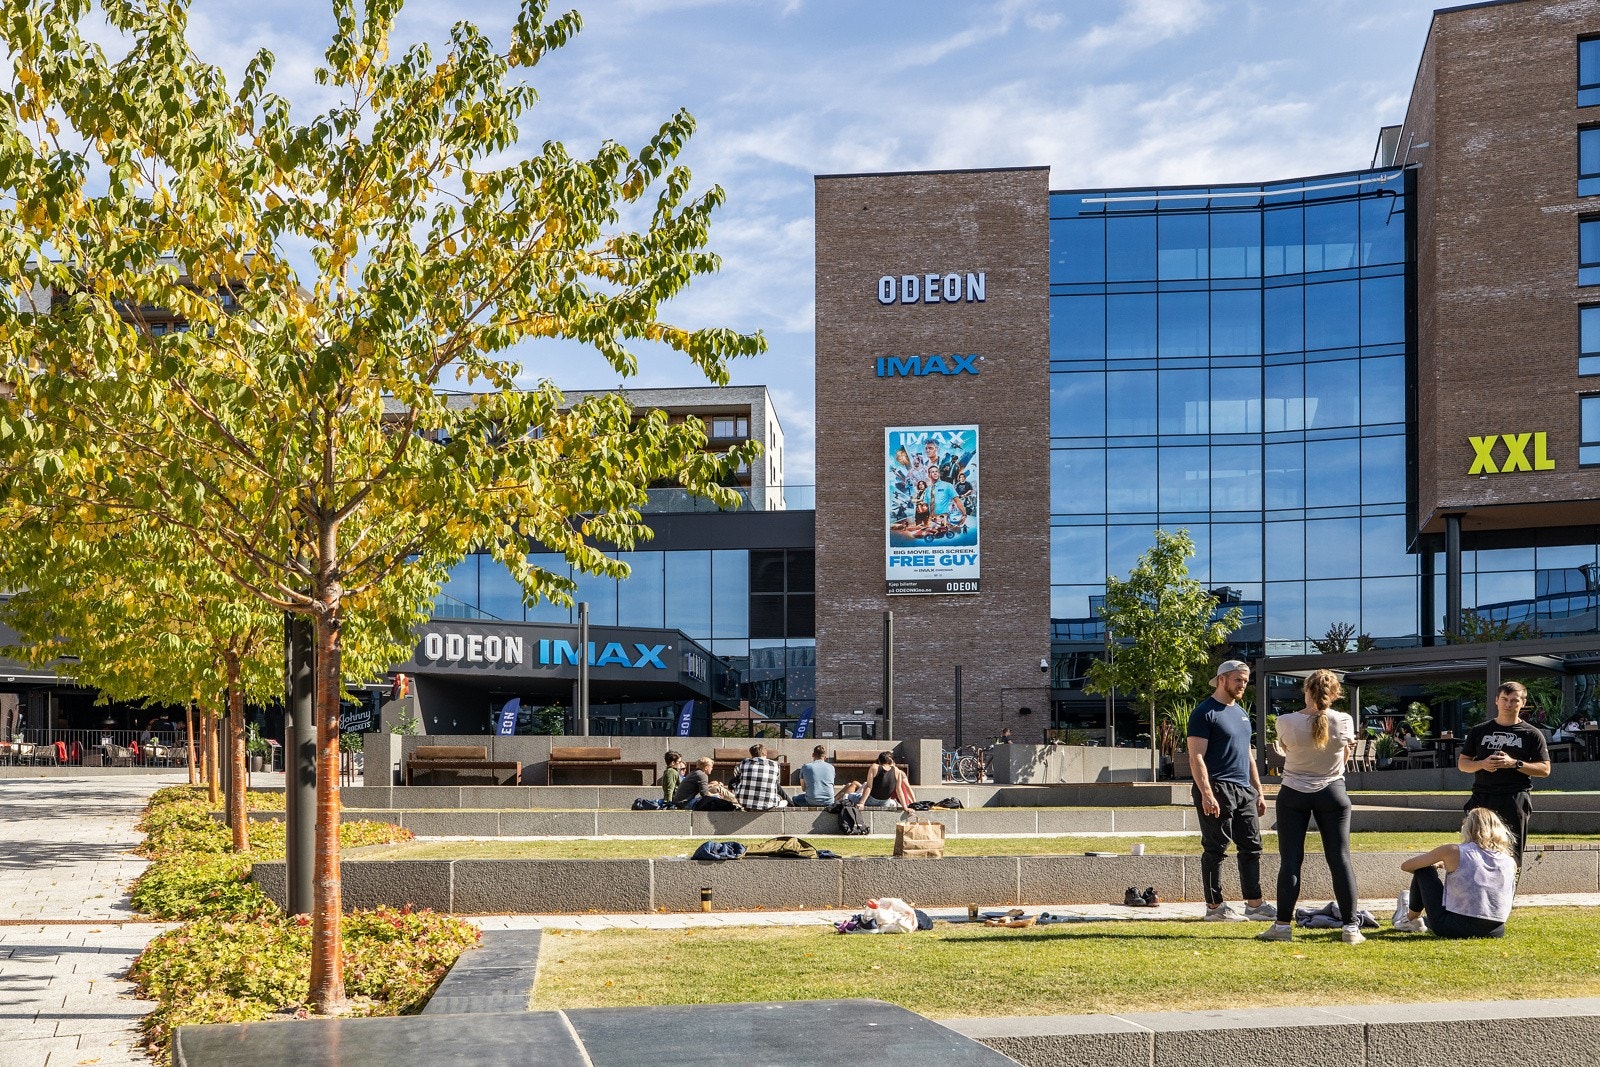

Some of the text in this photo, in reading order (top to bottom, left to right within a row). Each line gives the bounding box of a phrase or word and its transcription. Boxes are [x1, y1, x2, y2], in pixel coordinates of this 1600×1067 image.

[878, 272, 986, 304] ODEON
[876, 354, 980, 377] IMAX
[900, 431, 965, 445] IMAX
[1467, 432, 1556, 475] XXL
[889, 554, 978, 567] FREE GUY
[946, 582, 978, 591] ODEON
[424, 632, 523, 664] ODEON
[539, 639, 668, 669] IMAX
[340, 711, 370, 729] Johnny
